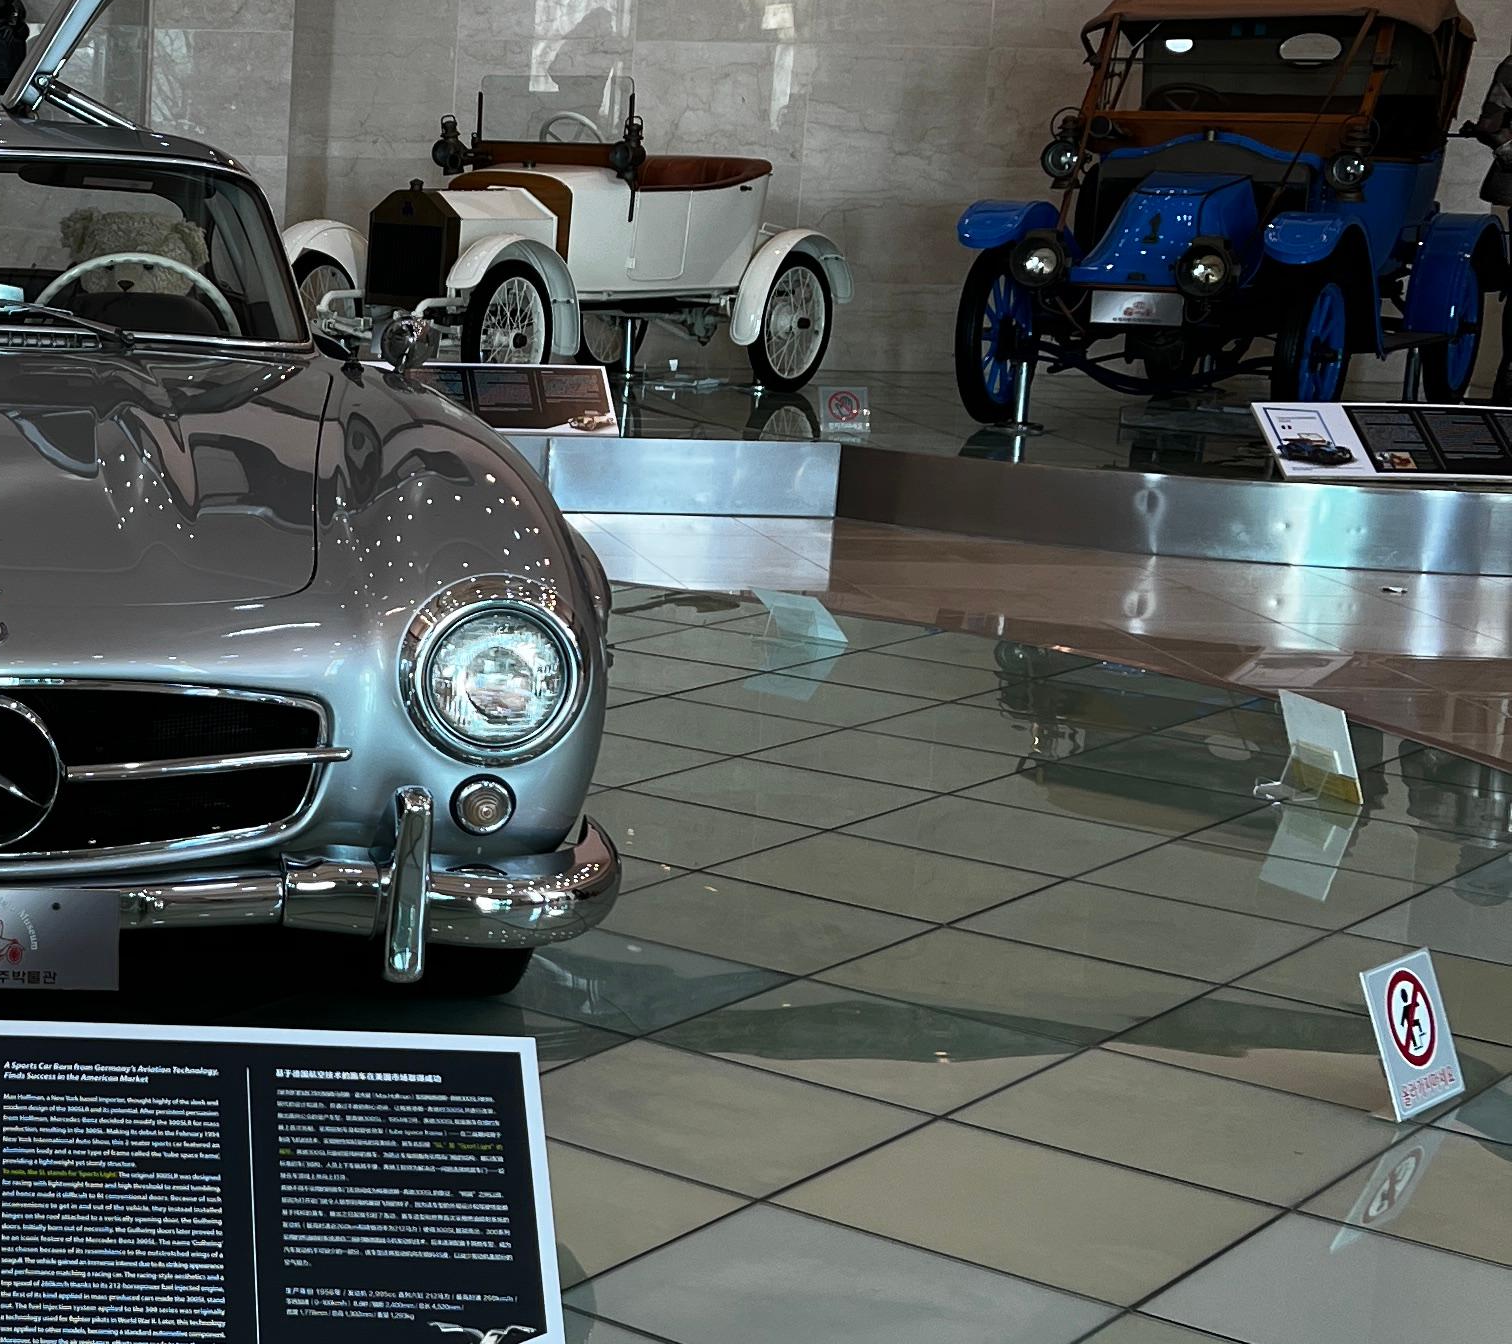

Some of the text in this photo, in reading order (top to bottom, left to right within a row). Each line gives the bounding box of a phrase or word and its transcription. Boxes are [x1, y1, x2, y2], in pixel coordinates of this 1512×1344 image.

[4, 1060, 218, 1076] A Sports Car Born from Germany's Aviation Technology,
[3, 1071, 148, 1084] Finds Success in the American Market
